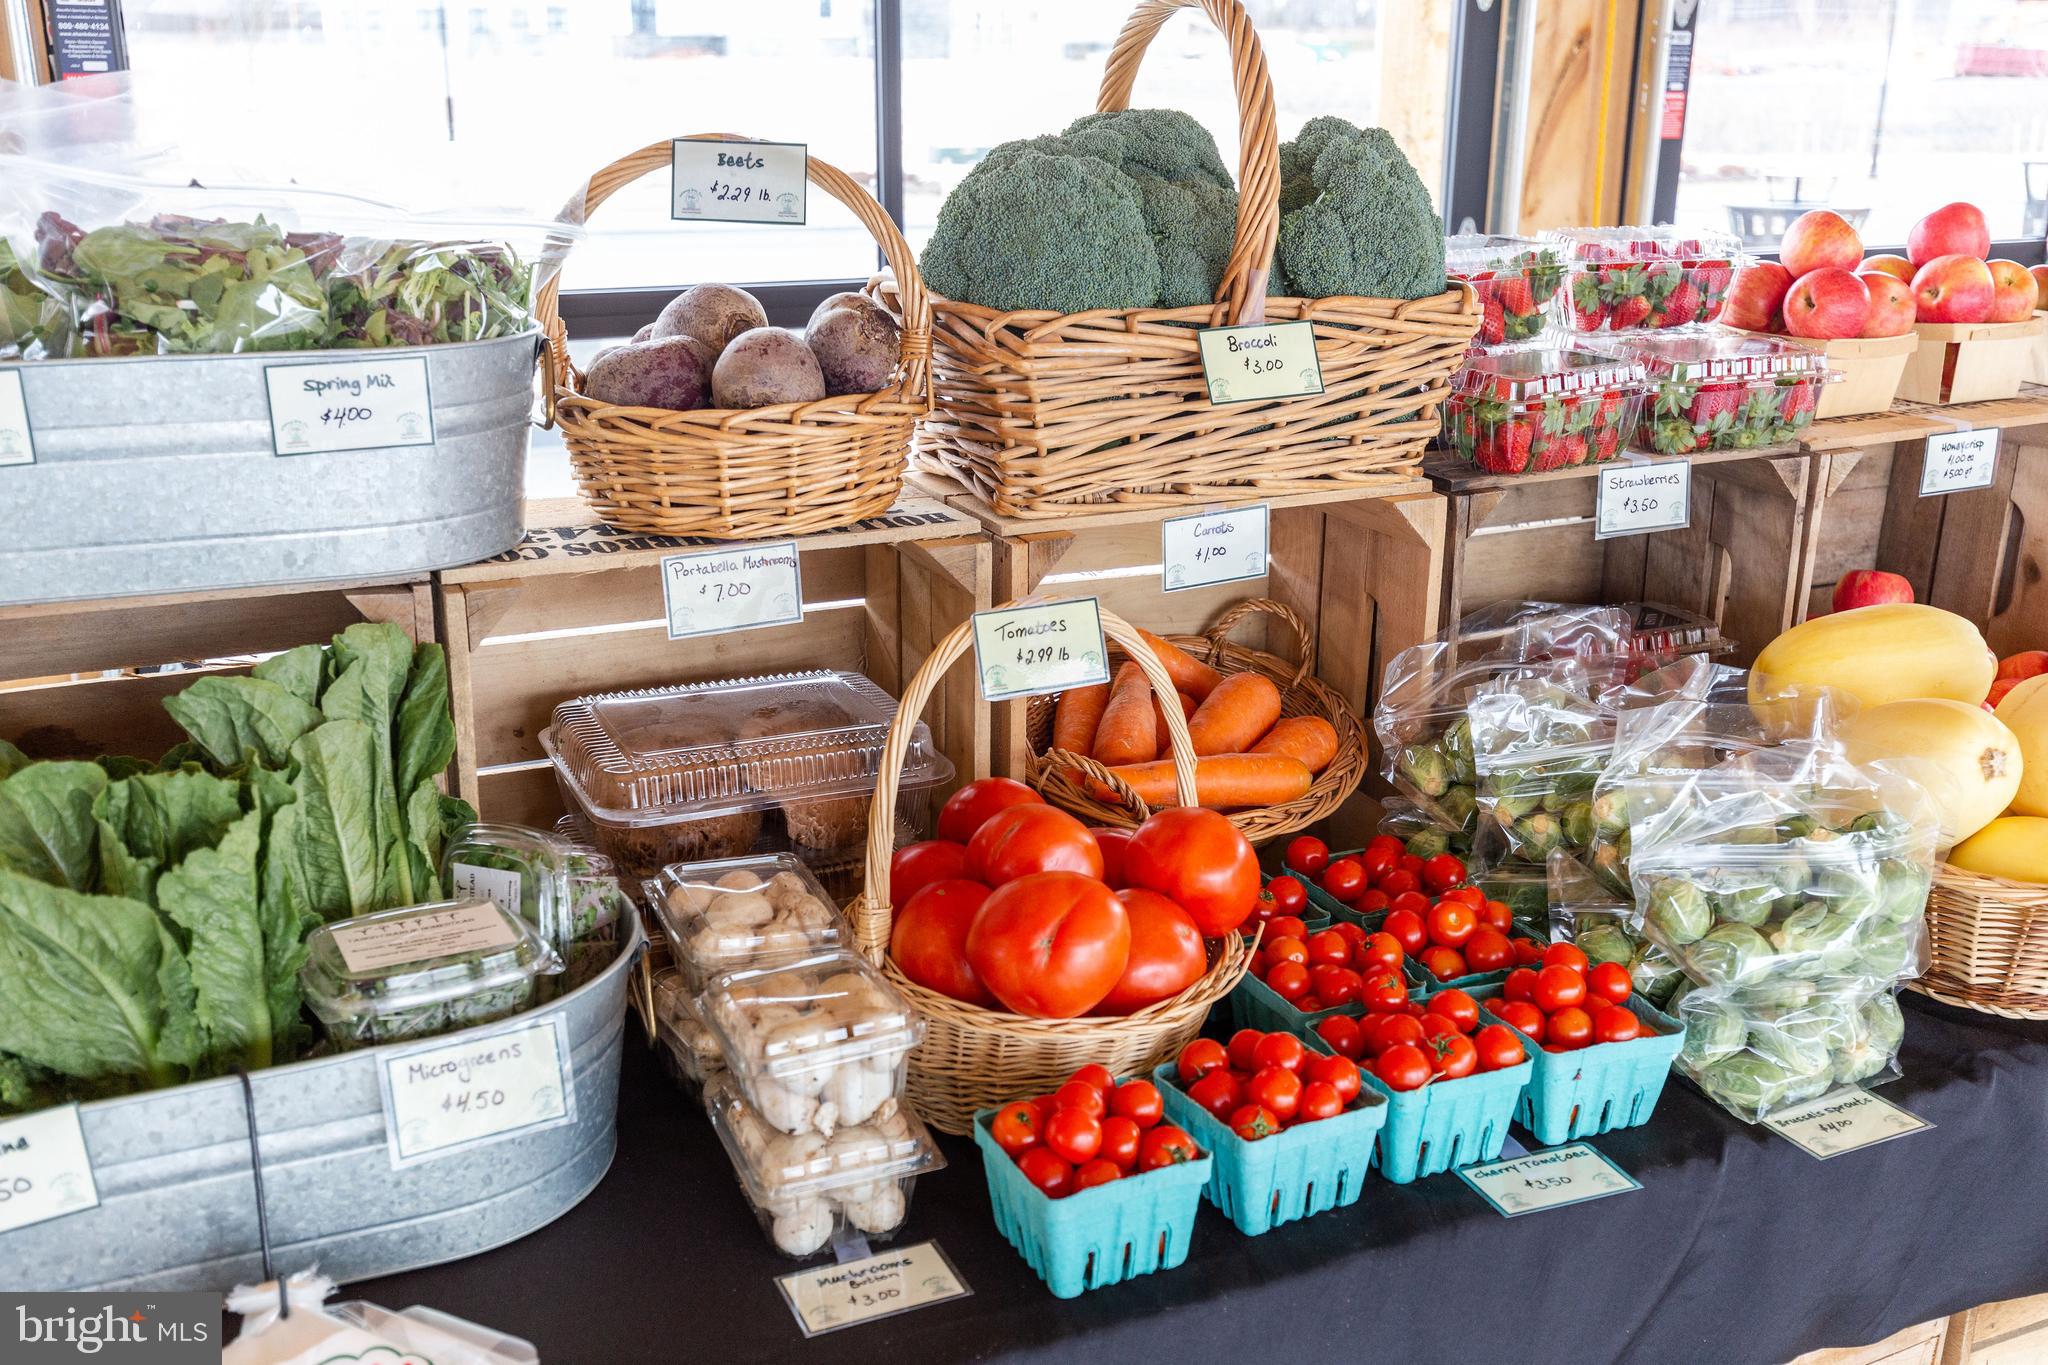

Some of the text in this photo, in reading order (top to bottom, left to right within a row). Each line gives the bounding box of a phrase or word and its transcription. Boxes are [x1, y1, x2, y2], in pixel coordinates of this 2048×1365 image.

[717, 152, 765, 170] Beets
[710, 180, 751, 203] $2.29
[758, 189, 771, 202] lb.
[1226, 333, 1278, 353] Broccoli
[1244, 356, 1284, 375] $3.00
[366, 373, 396, 389] Mix
[1609, 473, 1680, 490] Strawberries
[1623, 496, 1659, 514] $3.50
[1193, 521, 1235, 538] Carrots
[1195, 546, 1227, 564] $1.00
[668, 560, 739, 580] Portabella
[993, 619, 1067, 642] Tomatoes
[1016, 646, 1070, 665] $2.99 lb
[408, 1042, 523, 1084] Microgreens
[441, 1089, 506, 1114] $4.50
